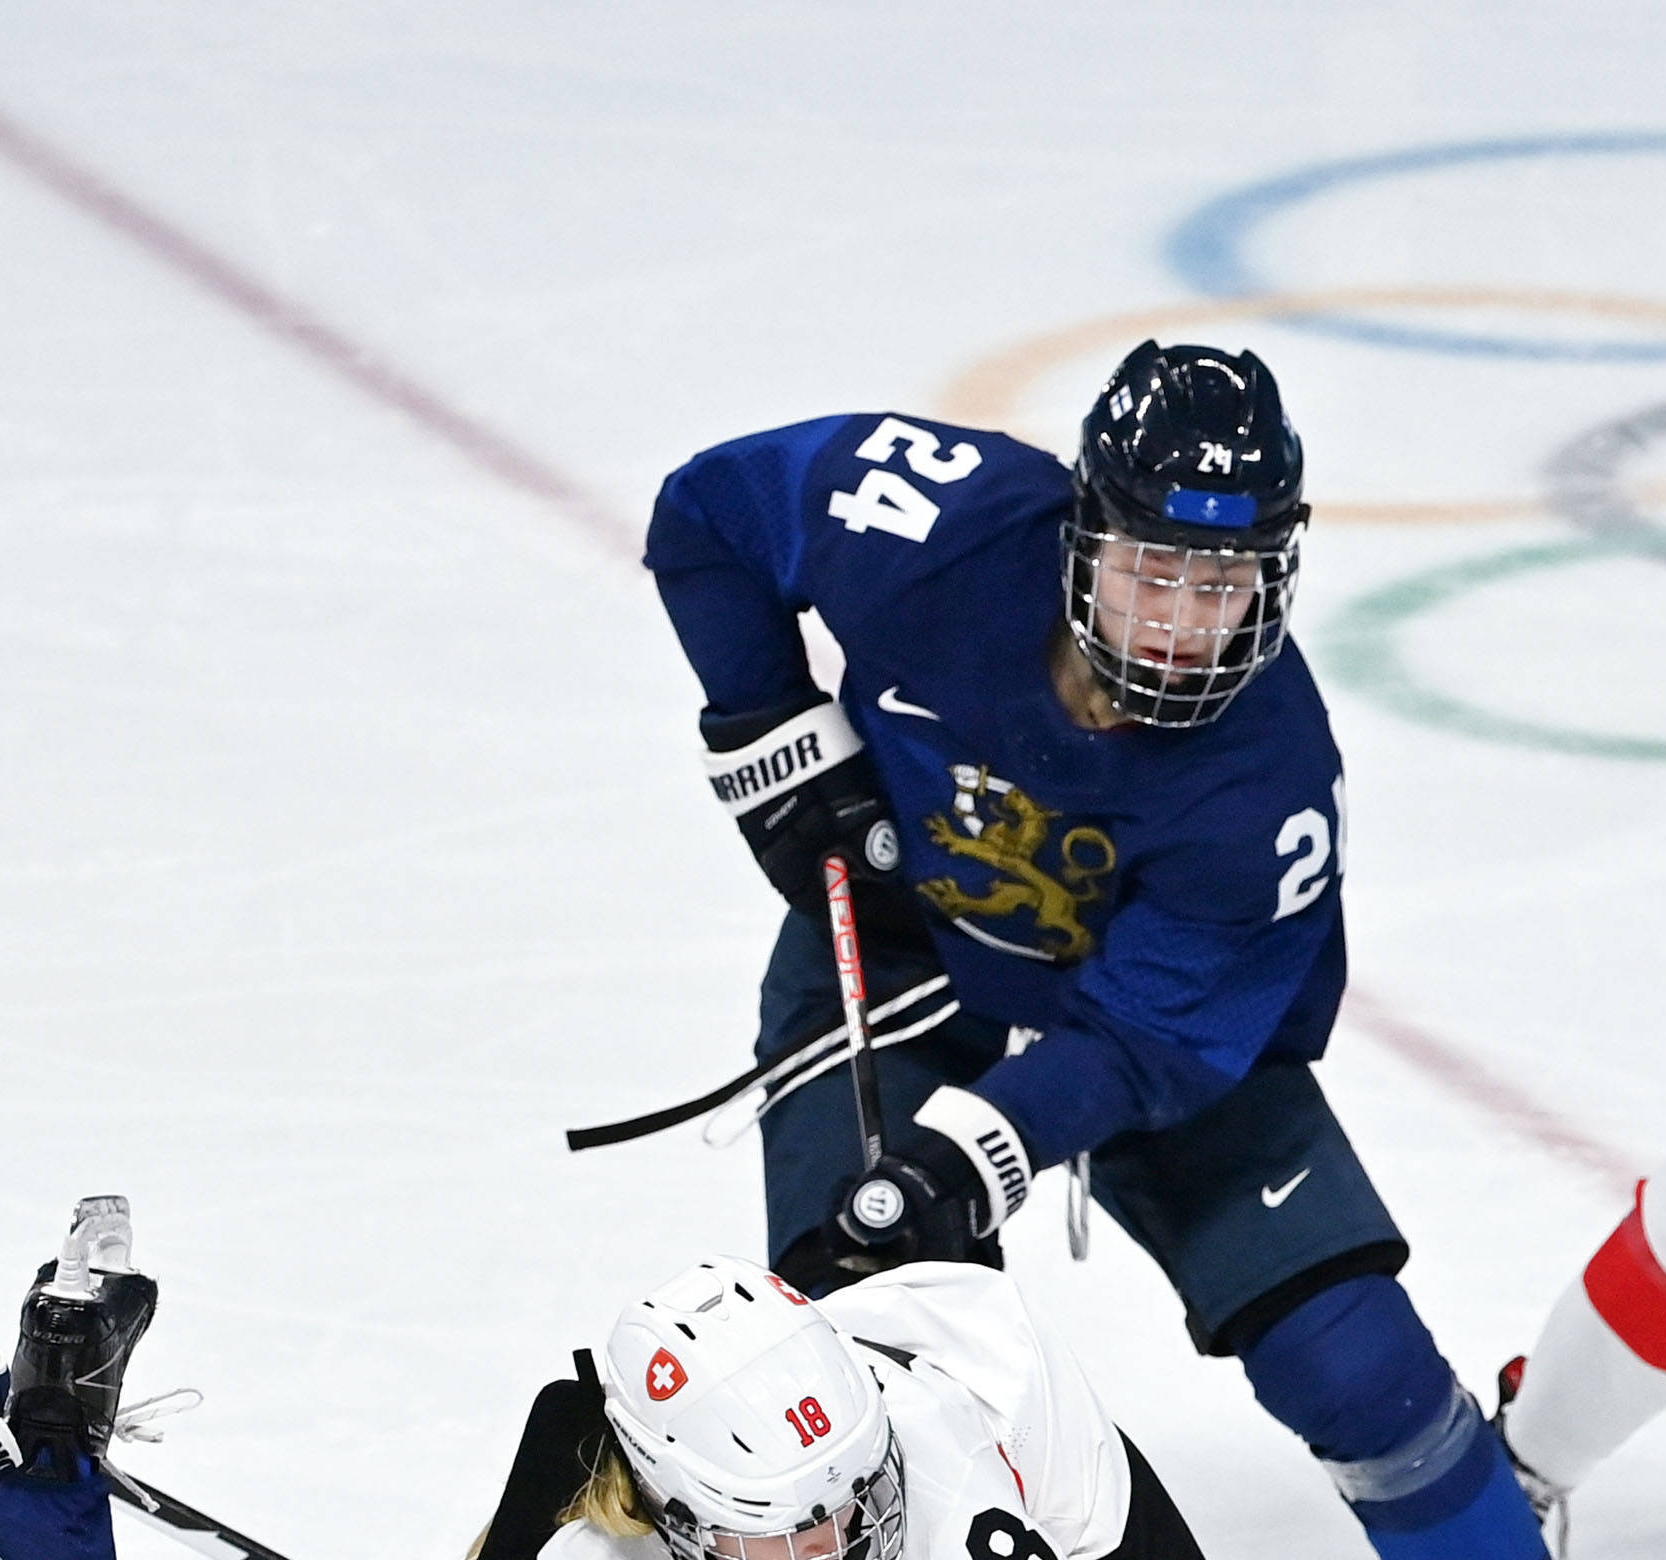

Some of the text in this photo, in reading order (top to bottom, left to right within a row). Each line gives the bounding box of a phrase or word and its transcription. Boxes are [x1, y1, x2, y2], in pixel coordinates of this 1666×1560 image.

[828, 416, 983, 544] 24
[1196, 441, 1233, 475] 24
[1271, 774, 1348, 924] 2
[785, 1396, 832, 1448] 18
